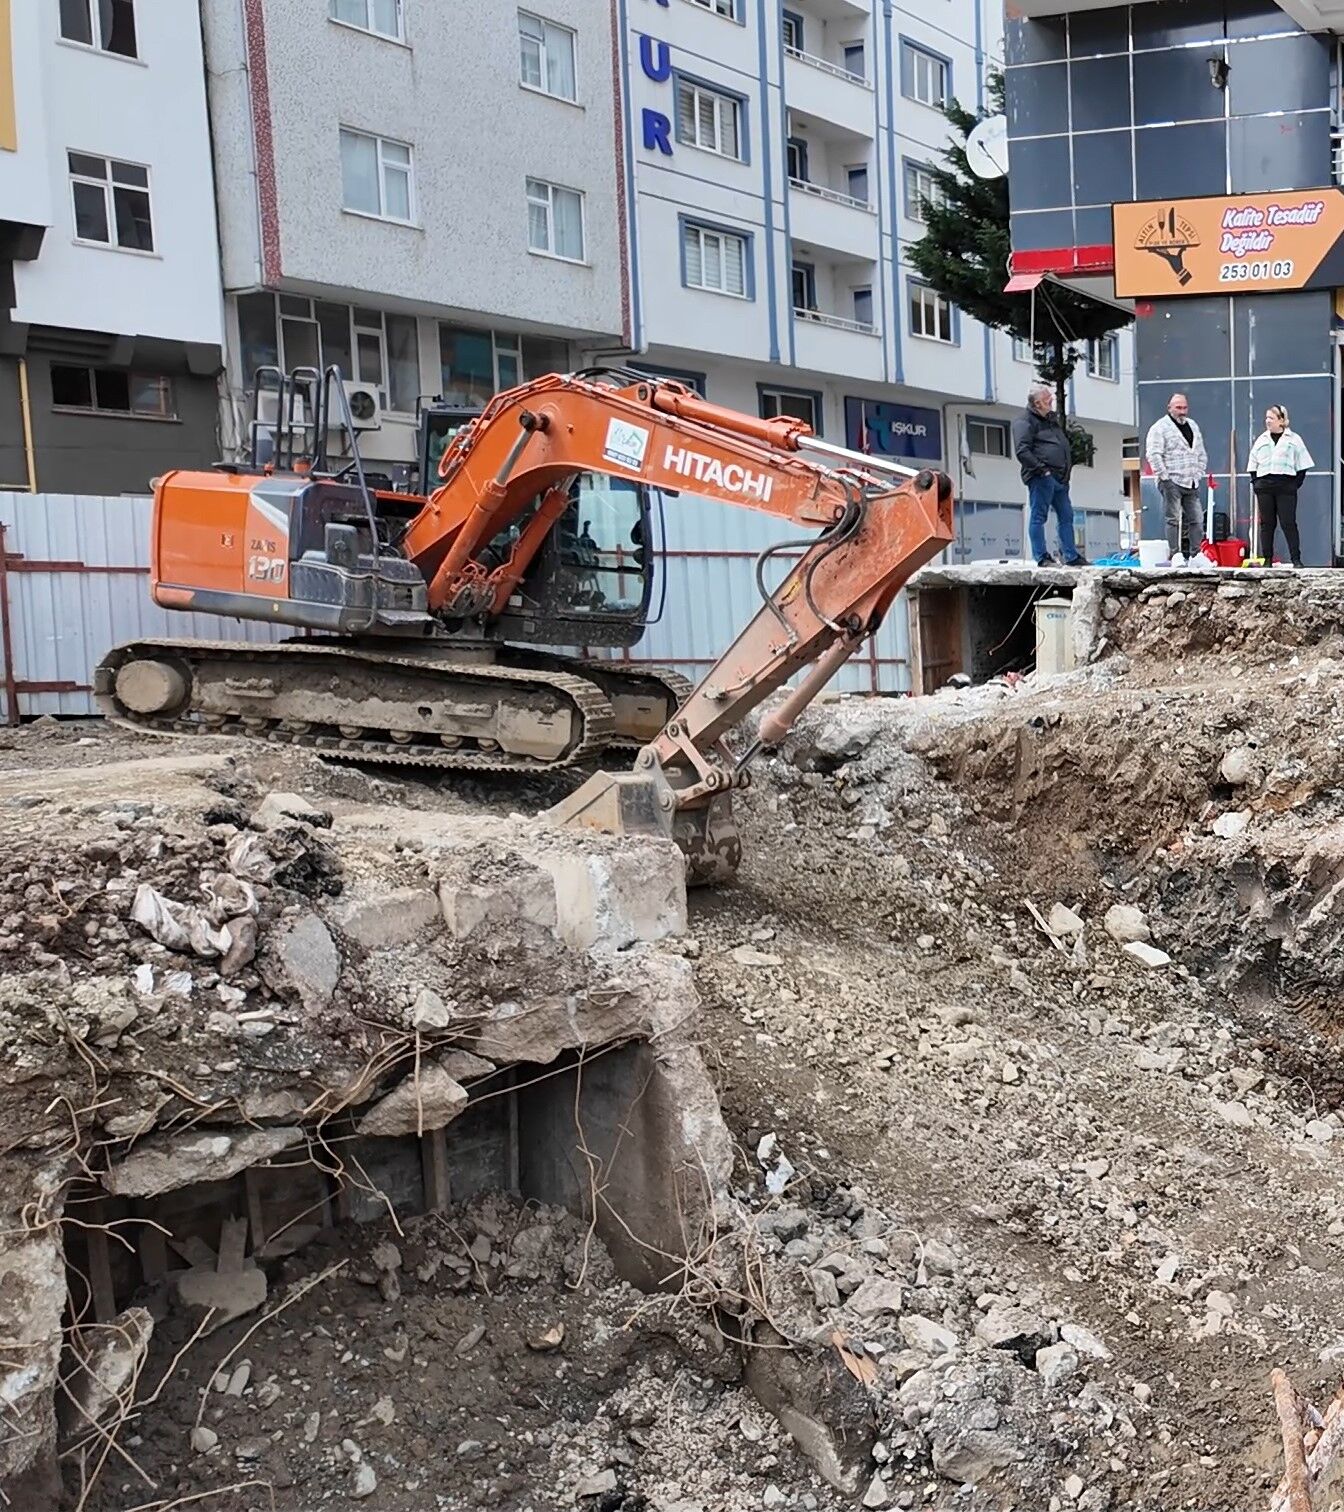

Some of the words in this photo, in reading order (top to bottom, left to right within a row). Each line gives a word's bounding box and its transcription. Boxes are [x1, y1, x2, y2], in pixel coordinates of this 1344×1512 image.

[639, 0, 674, 157] UR
[1222, 207, 1264, 229] Kalite
[1266, 201, 1324, 226] Tesadüf
[1220, 229, 1274, 258] Değildir
[1221, 264, 1248, 279] 253
[1252, 263, 1268, 278] 01
[1273, 261, 1292, 276] 03
[662, 445, 773, 503] HITACHI
